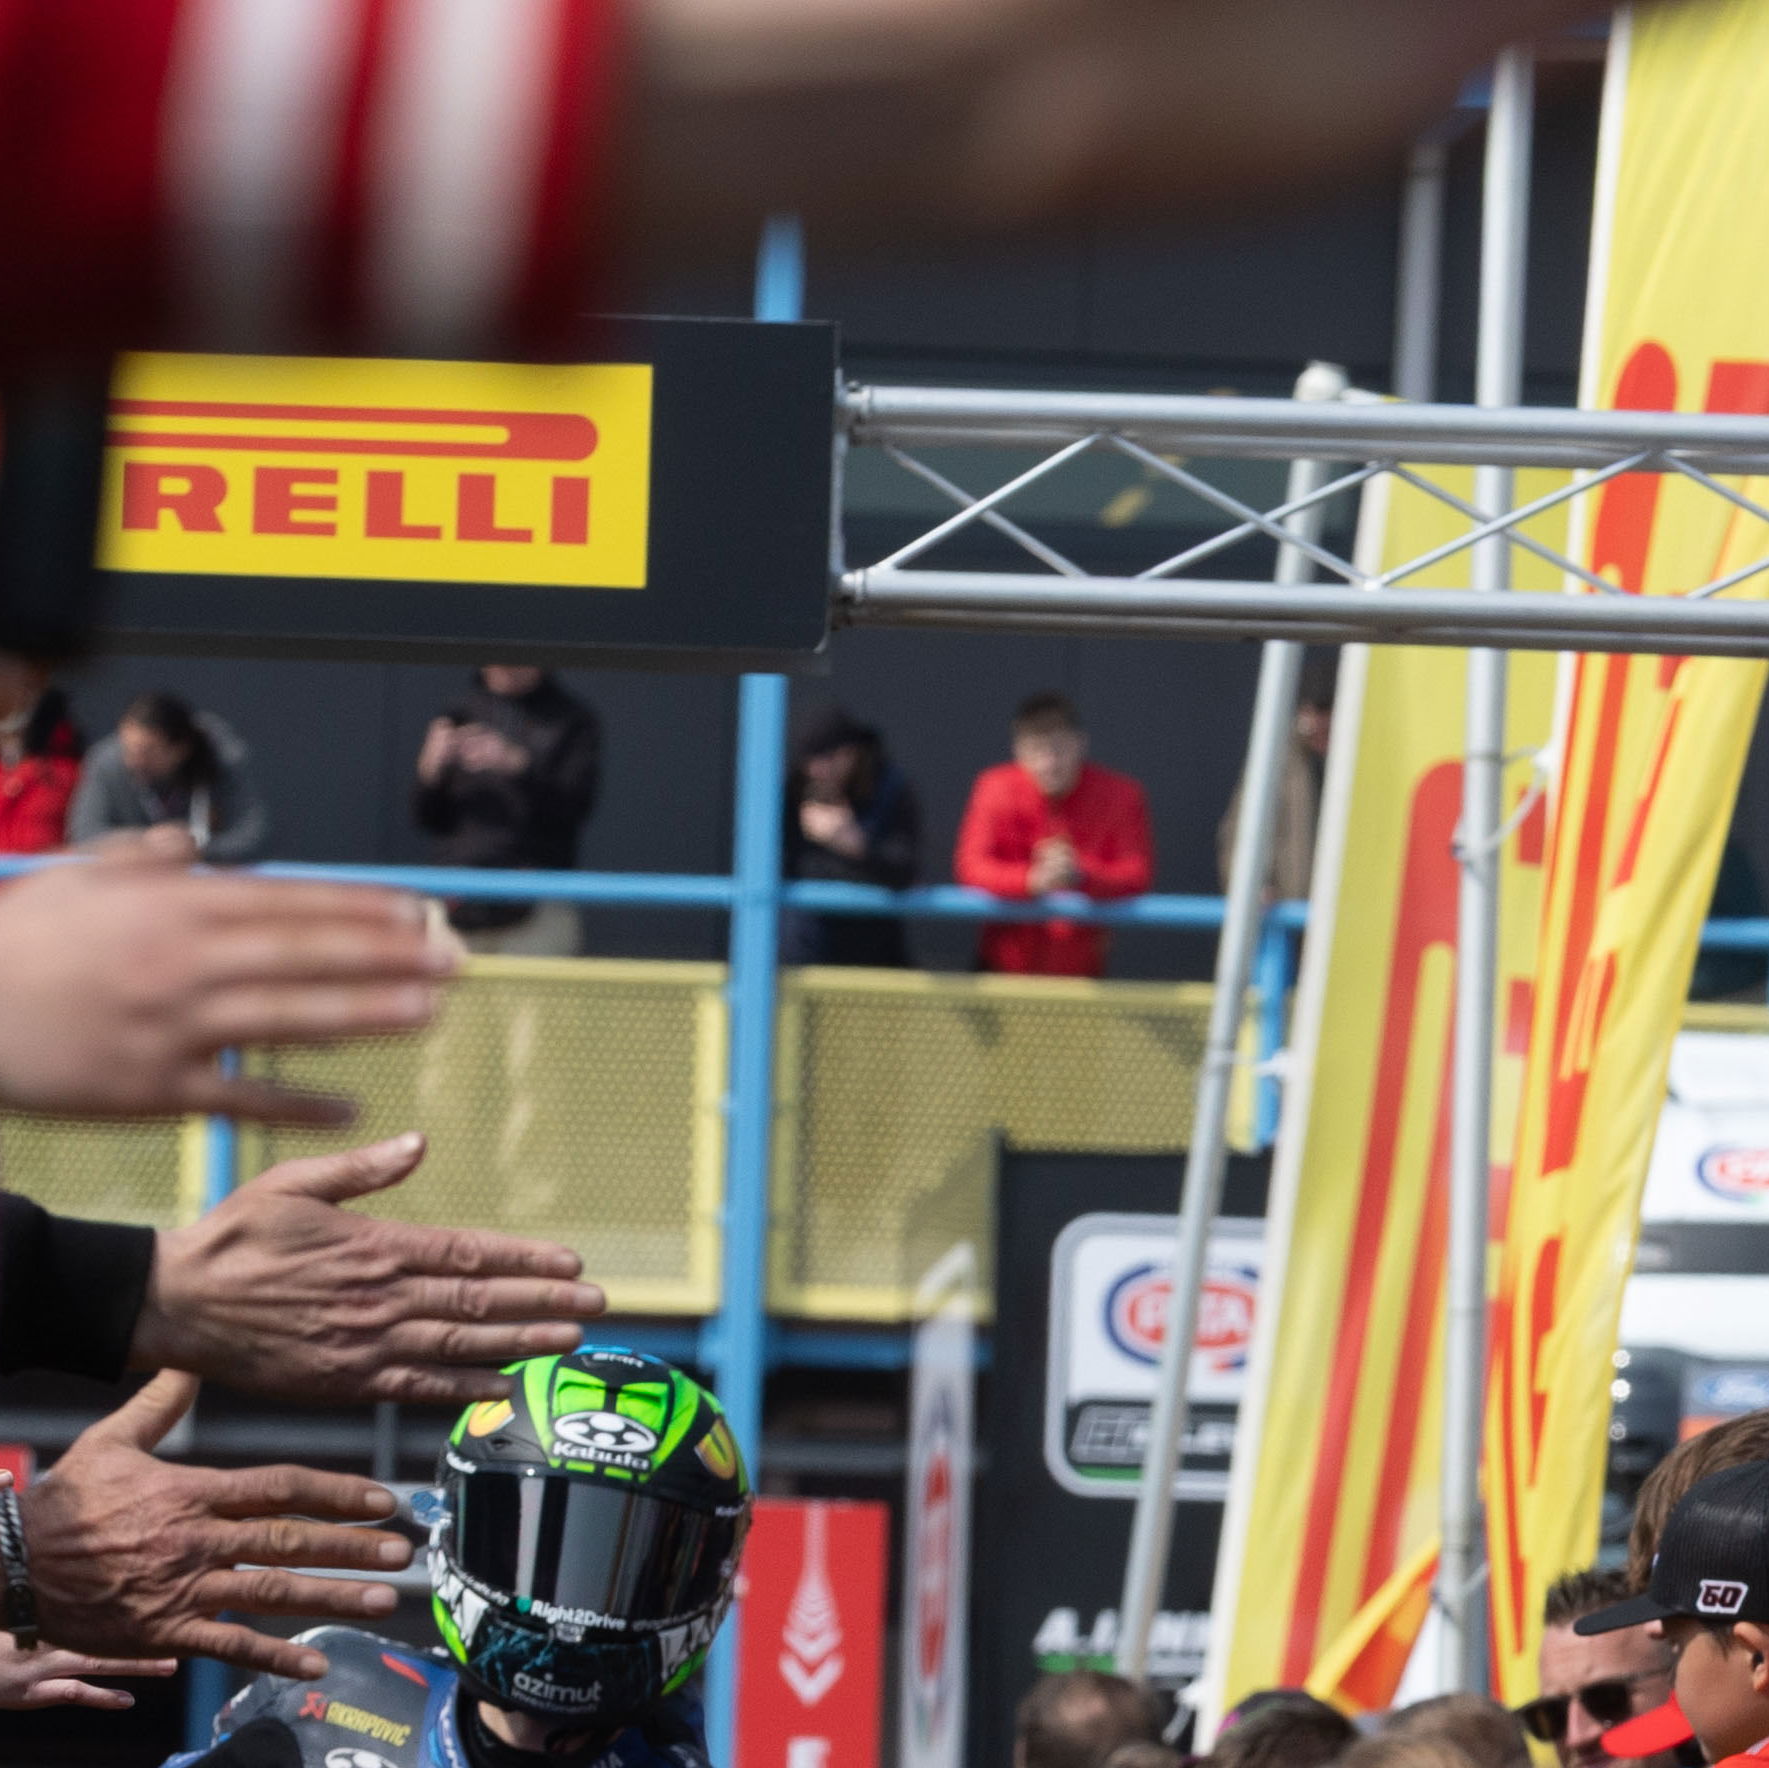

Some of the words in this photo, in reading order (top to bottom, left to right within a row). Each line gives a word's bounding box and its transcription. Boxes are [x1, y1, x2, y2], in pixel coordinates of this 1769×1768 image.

[552, 1440, 651, 1470] Kabuto
[531, 1600, 627, 1631] Right2Drive
[513, 1672, 603, 1702] azimut
